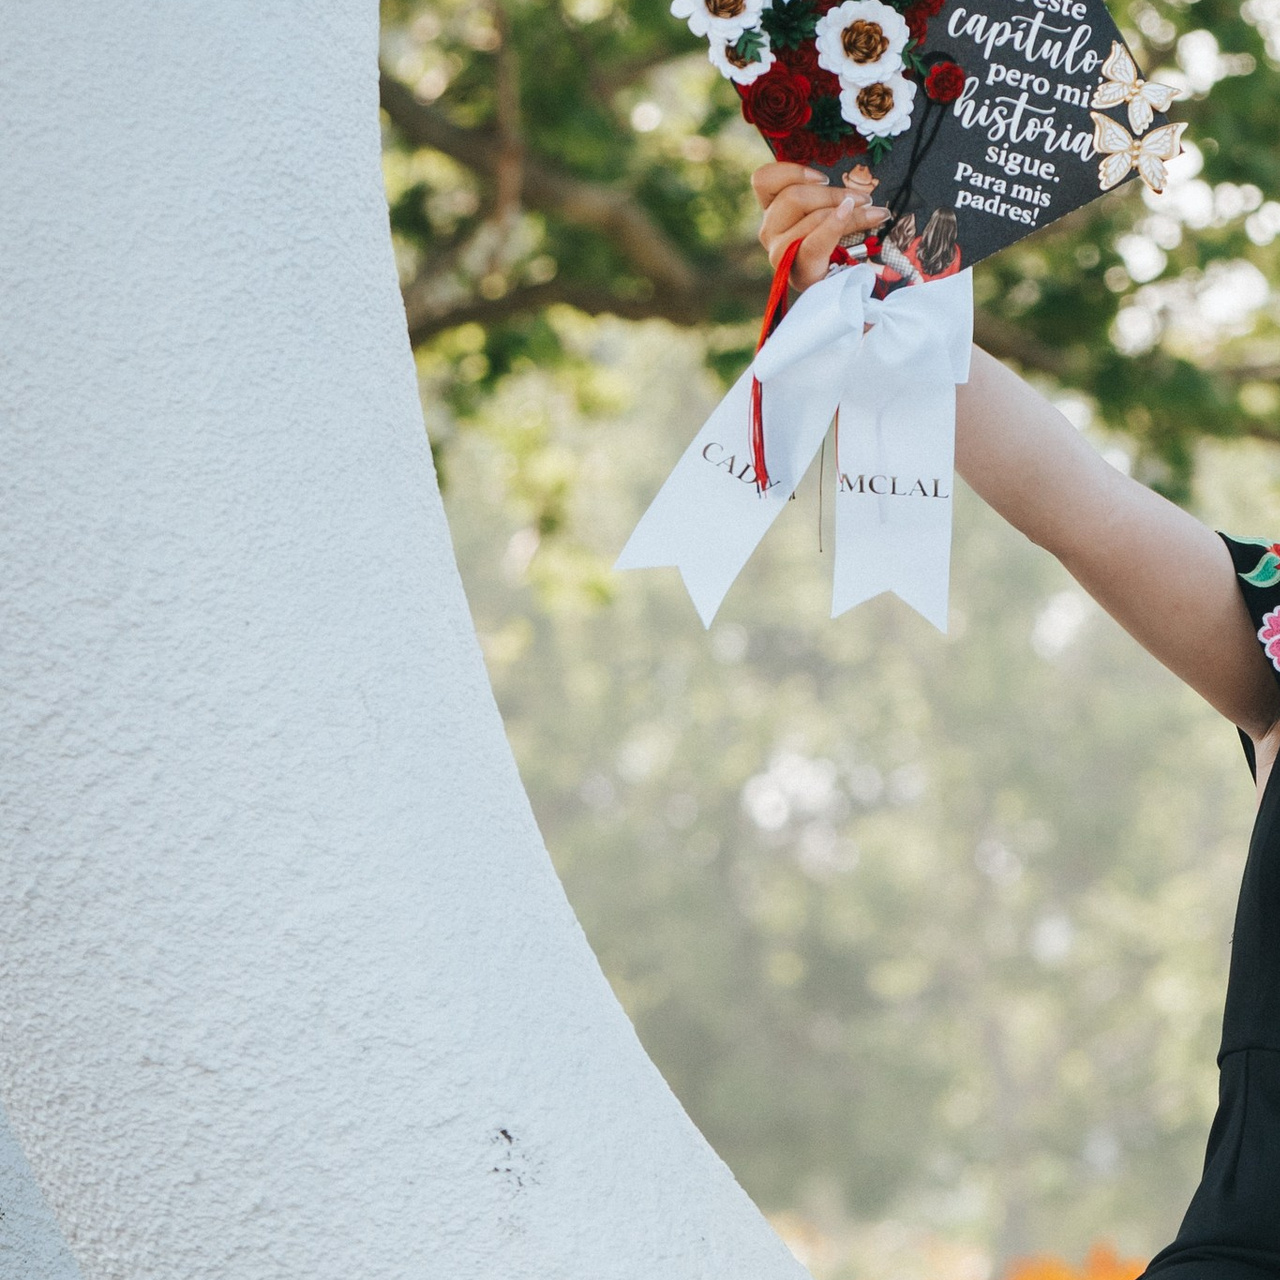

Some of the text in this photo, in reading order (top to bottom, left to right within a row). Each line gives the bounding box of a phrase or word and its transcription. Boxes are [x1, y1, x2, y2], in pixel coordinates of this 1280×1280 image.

[985, 62, 1092, 108] pero mi
[952, 76, 1097, 162] historia
[953, 162, 1051, 208] Para mis
[985, 144, 1060, 183] sigue.
[954, 189, 1040, 226] padres!
